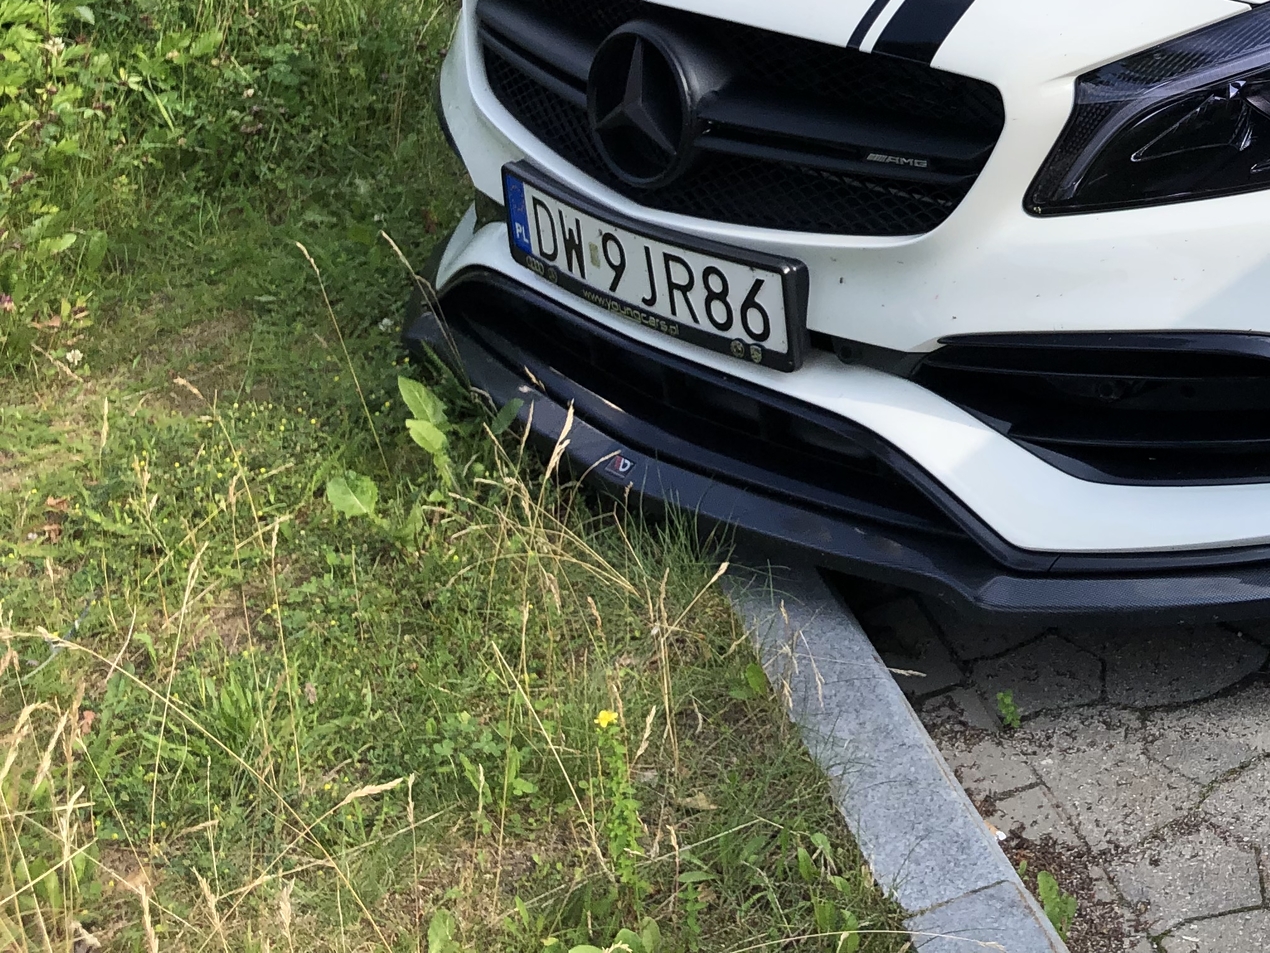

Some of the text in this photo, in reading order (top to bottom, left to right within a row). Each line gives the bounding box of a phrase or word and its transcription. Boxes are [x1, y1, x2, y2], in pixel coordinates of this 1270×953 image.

[884, 155, 928, 168] AMG
[515, 222, 529, 245] PL
[532, 195, 770, 343] DW 9JR86
[582, 289, 680, 336] www.youngcars.pl
